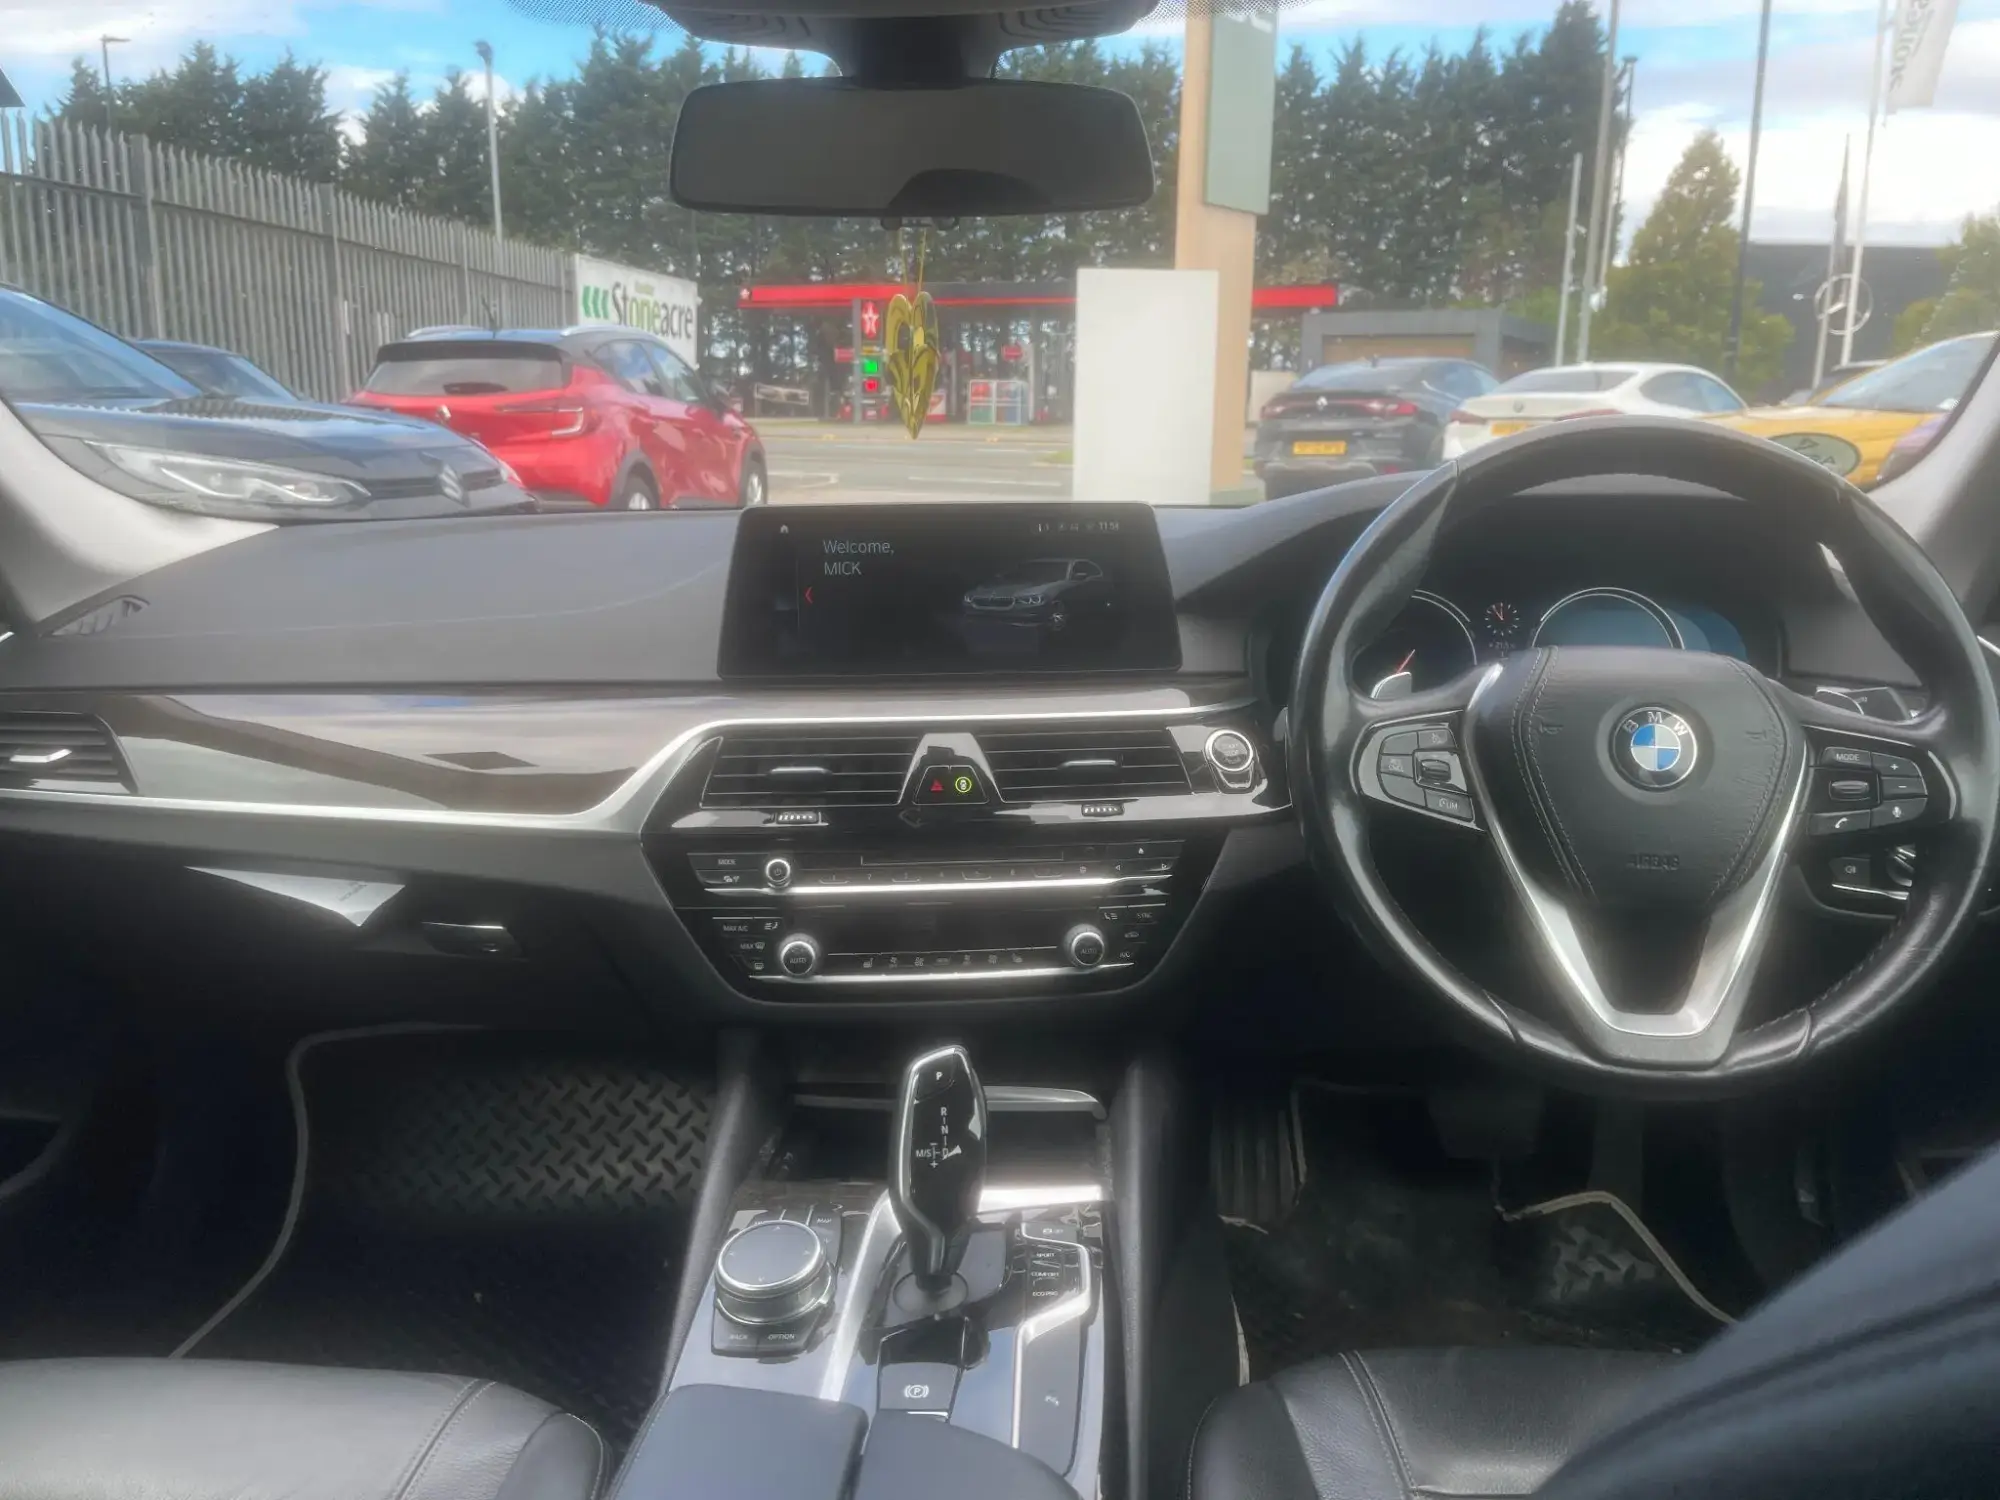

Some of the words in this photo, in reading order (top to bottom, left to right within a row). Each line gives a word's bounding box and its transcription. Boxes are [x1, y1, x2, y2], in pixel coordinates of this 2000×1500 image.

[612, 281, 693, 339] Stoneacre
[823, 540, 895, 555] Welcome,
[824, 561, 862, 575] MICK
[1623, 711, 1689, 737] BMW
[1836, 753, 1860, 762] MODE
[936, 1072, 943, 1080] P
[941, 1107, 947, 1116] R
[941, 1125, 948, 1134] N
[916, 1149, 932, 1157] M/S
[768, 1333, 795, 1341] OPTION
